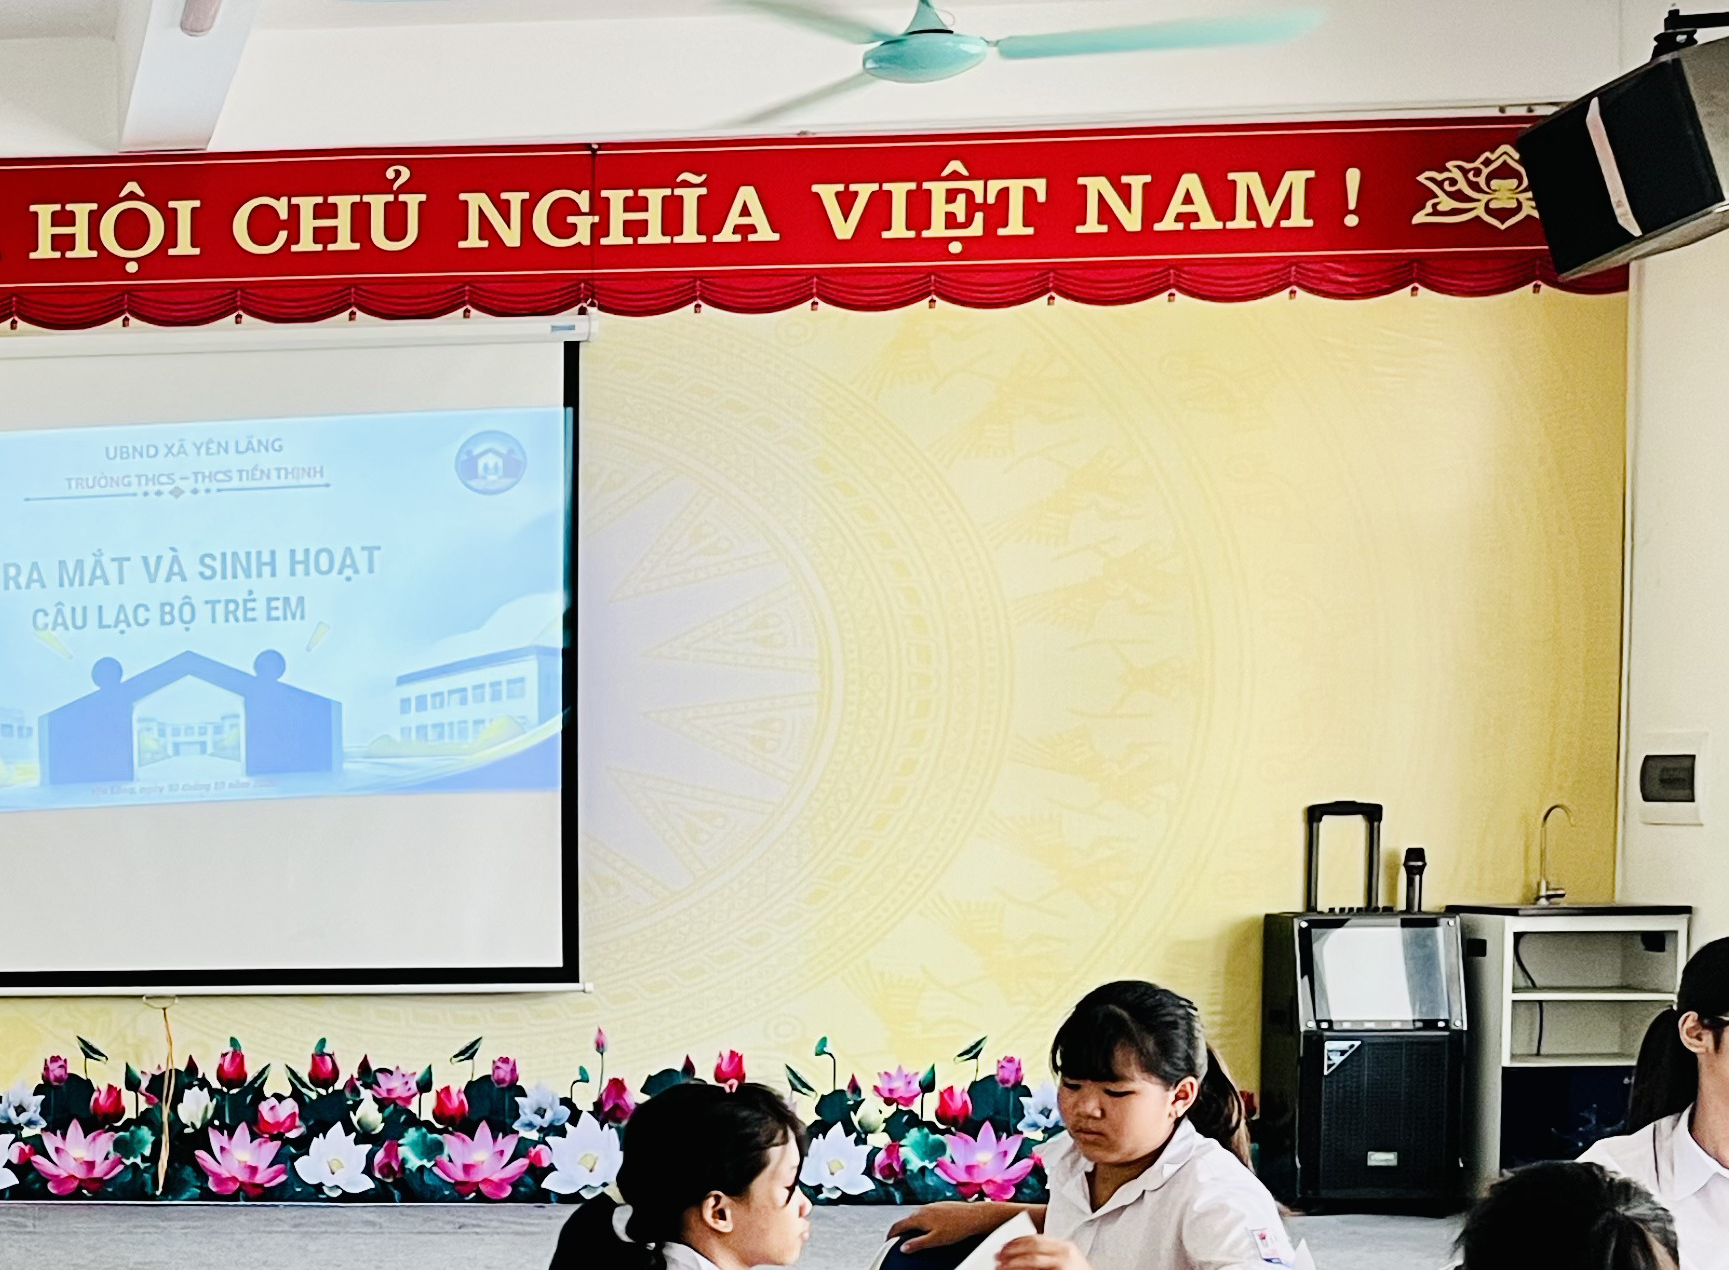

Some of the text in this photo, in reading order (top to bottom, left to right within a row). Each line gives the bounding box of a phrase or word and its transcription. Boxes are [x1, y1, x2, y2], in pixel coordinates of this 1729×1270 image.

[29, 181, 201, 273] HỘI
[232, 165, 426, 255] CHỦ
[457, 171, 780, 249] NGHĨA
[811, 159, 1047, 254] VIỆT
[1075, 169, 1315, 234] NAM
[105, 444, 159, 461] UBND
[163, 438, 188, 459] XÃ
[193, 438, 229, 457] YÊN
[135, 473, 176, 487] THCS
[192, 469, 233, 484] THCS
[3, 561, 47, 591] RA
[58, 548, 131, 588] MẮT
[141, 546, 188, 584] VÀ
[198, 549, 277, 581] SINH
[289, 545, 382, 582] HOẠT
[32, 589, 305, 635] CÂU LẠC BỘ TRẺ EM
